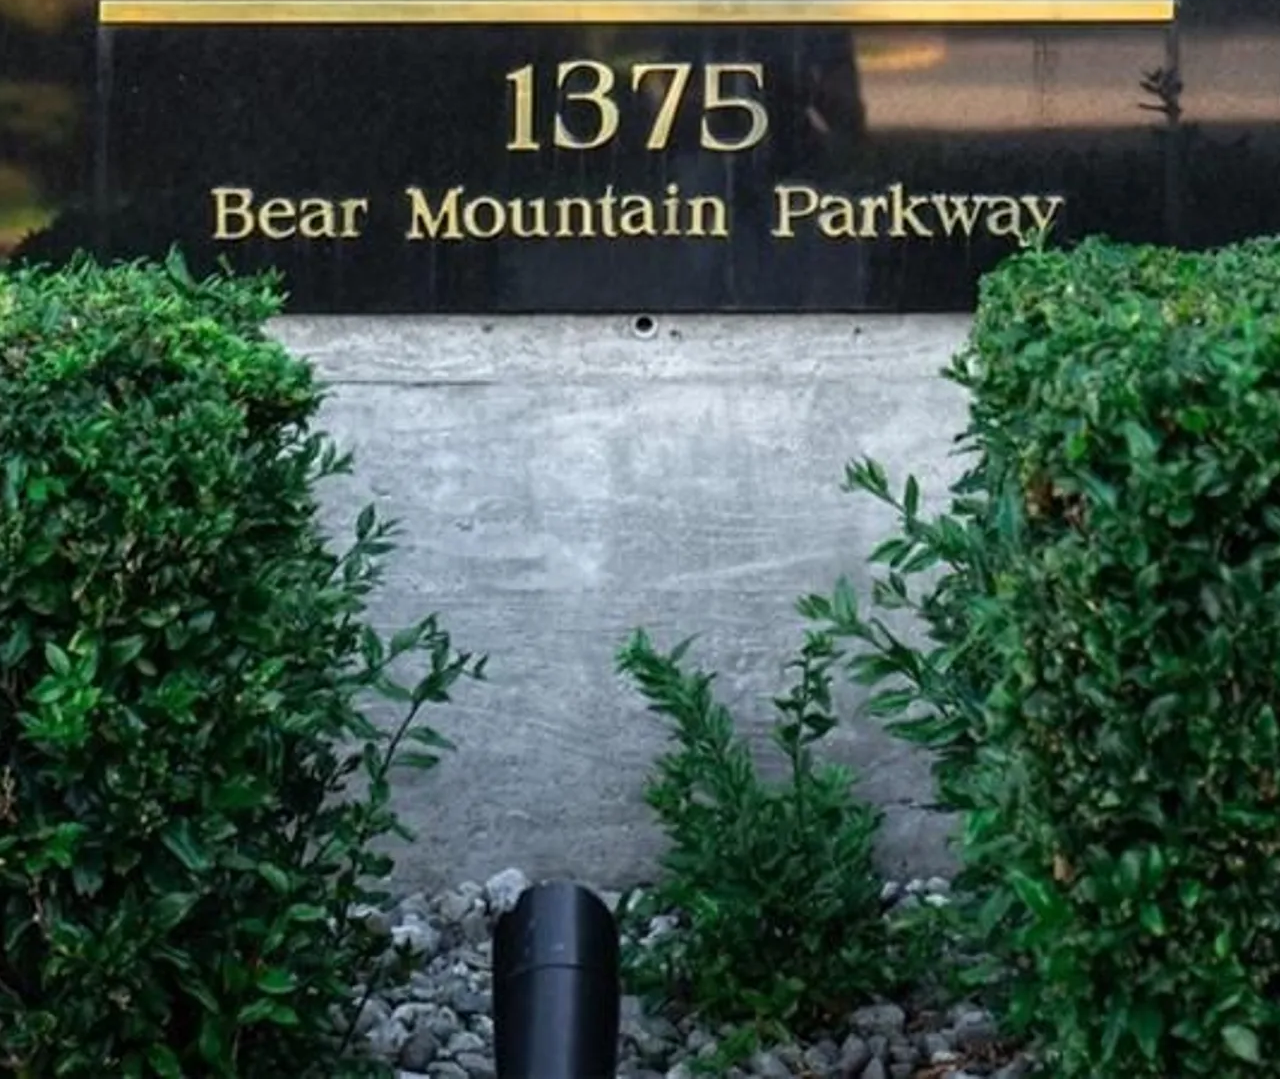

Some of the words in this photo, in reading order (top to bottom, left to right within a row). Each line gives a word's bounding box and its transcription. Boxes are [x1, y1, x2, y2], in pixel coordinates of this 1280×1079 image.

[503, 60, 770, 153] 1375
[211, 186, 369, 242] Bear
[405, 186, 729, 240] Mountain
[771, 185, 1066, 249] Parkway
